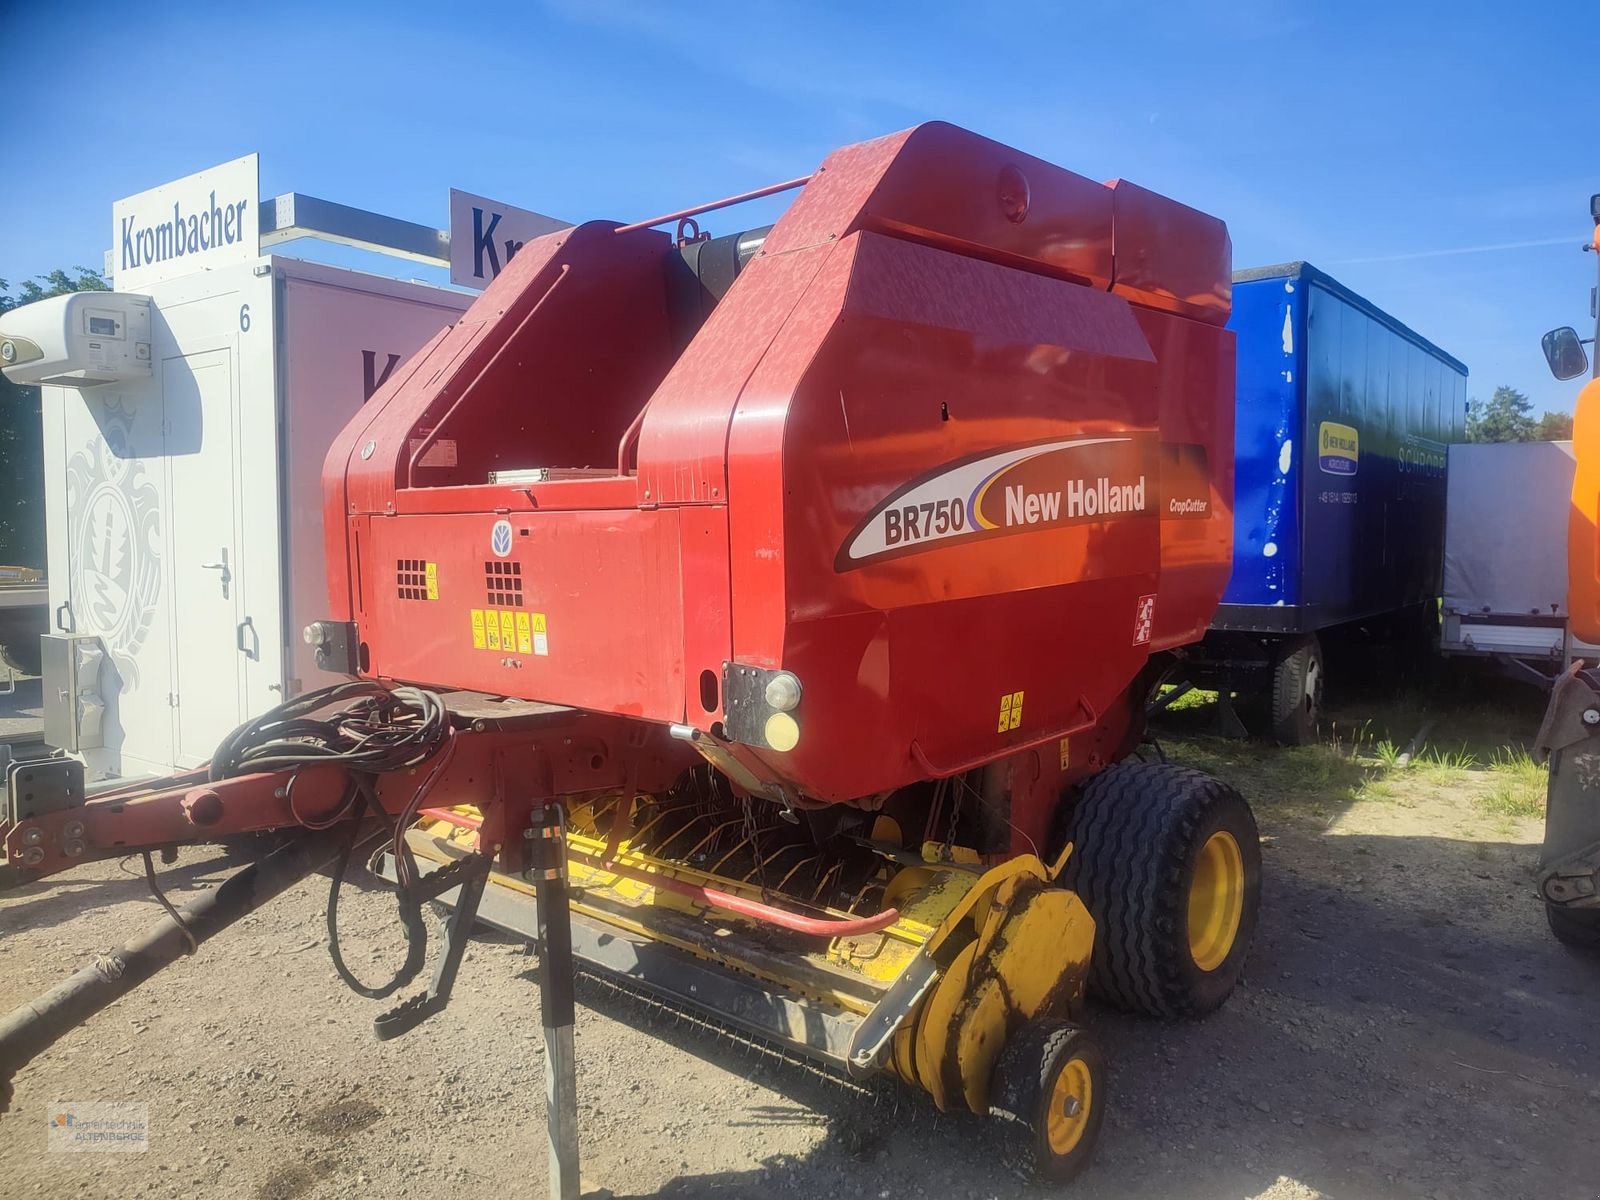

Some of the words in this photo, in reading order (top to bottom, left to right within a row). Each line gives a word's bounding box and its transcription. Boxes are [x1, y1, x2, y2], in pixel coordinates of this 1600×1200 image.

[121, 189, 248, 271] Krombacher
[239, 303, 251, 333] 6
[885, 496, 965, 546] BR750
[1005, 484, 1061, 527] New
[1067, 475, 1145, 518] Holland
[1169, 497, 1208, 516] CropCutter
